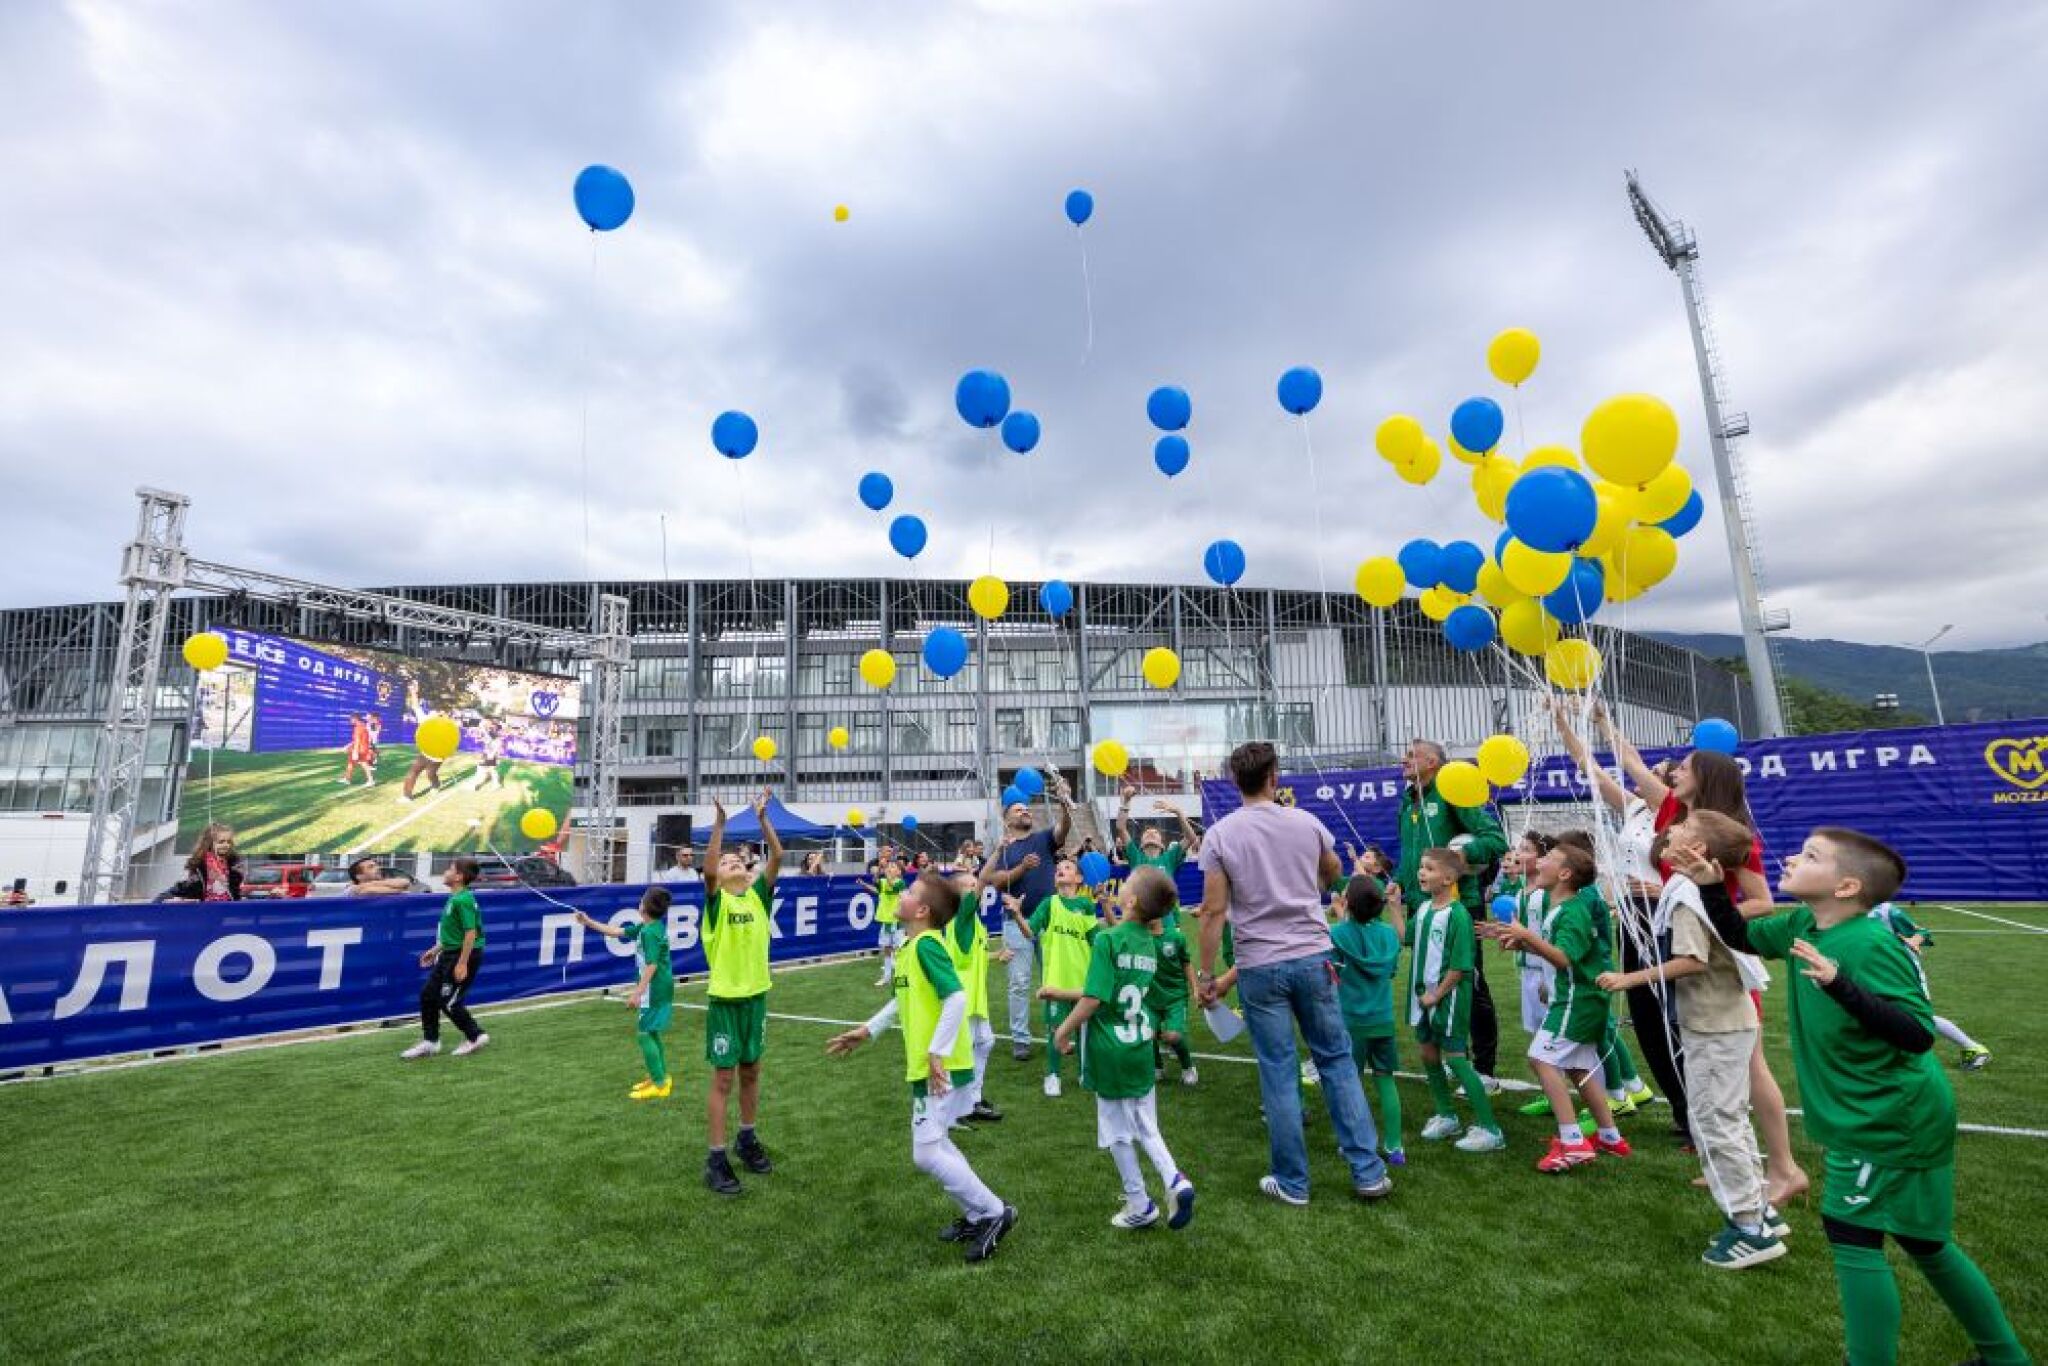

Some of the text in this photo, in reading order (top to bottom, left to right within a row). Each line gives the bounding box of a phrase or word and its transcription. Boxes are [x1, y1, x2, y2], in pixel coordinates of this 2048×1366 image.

[298, 656, 325, 676] ОД
[1810, 744, 1937, 771] ИГРА
[0, 927, 363, 1024] ЛОТ
